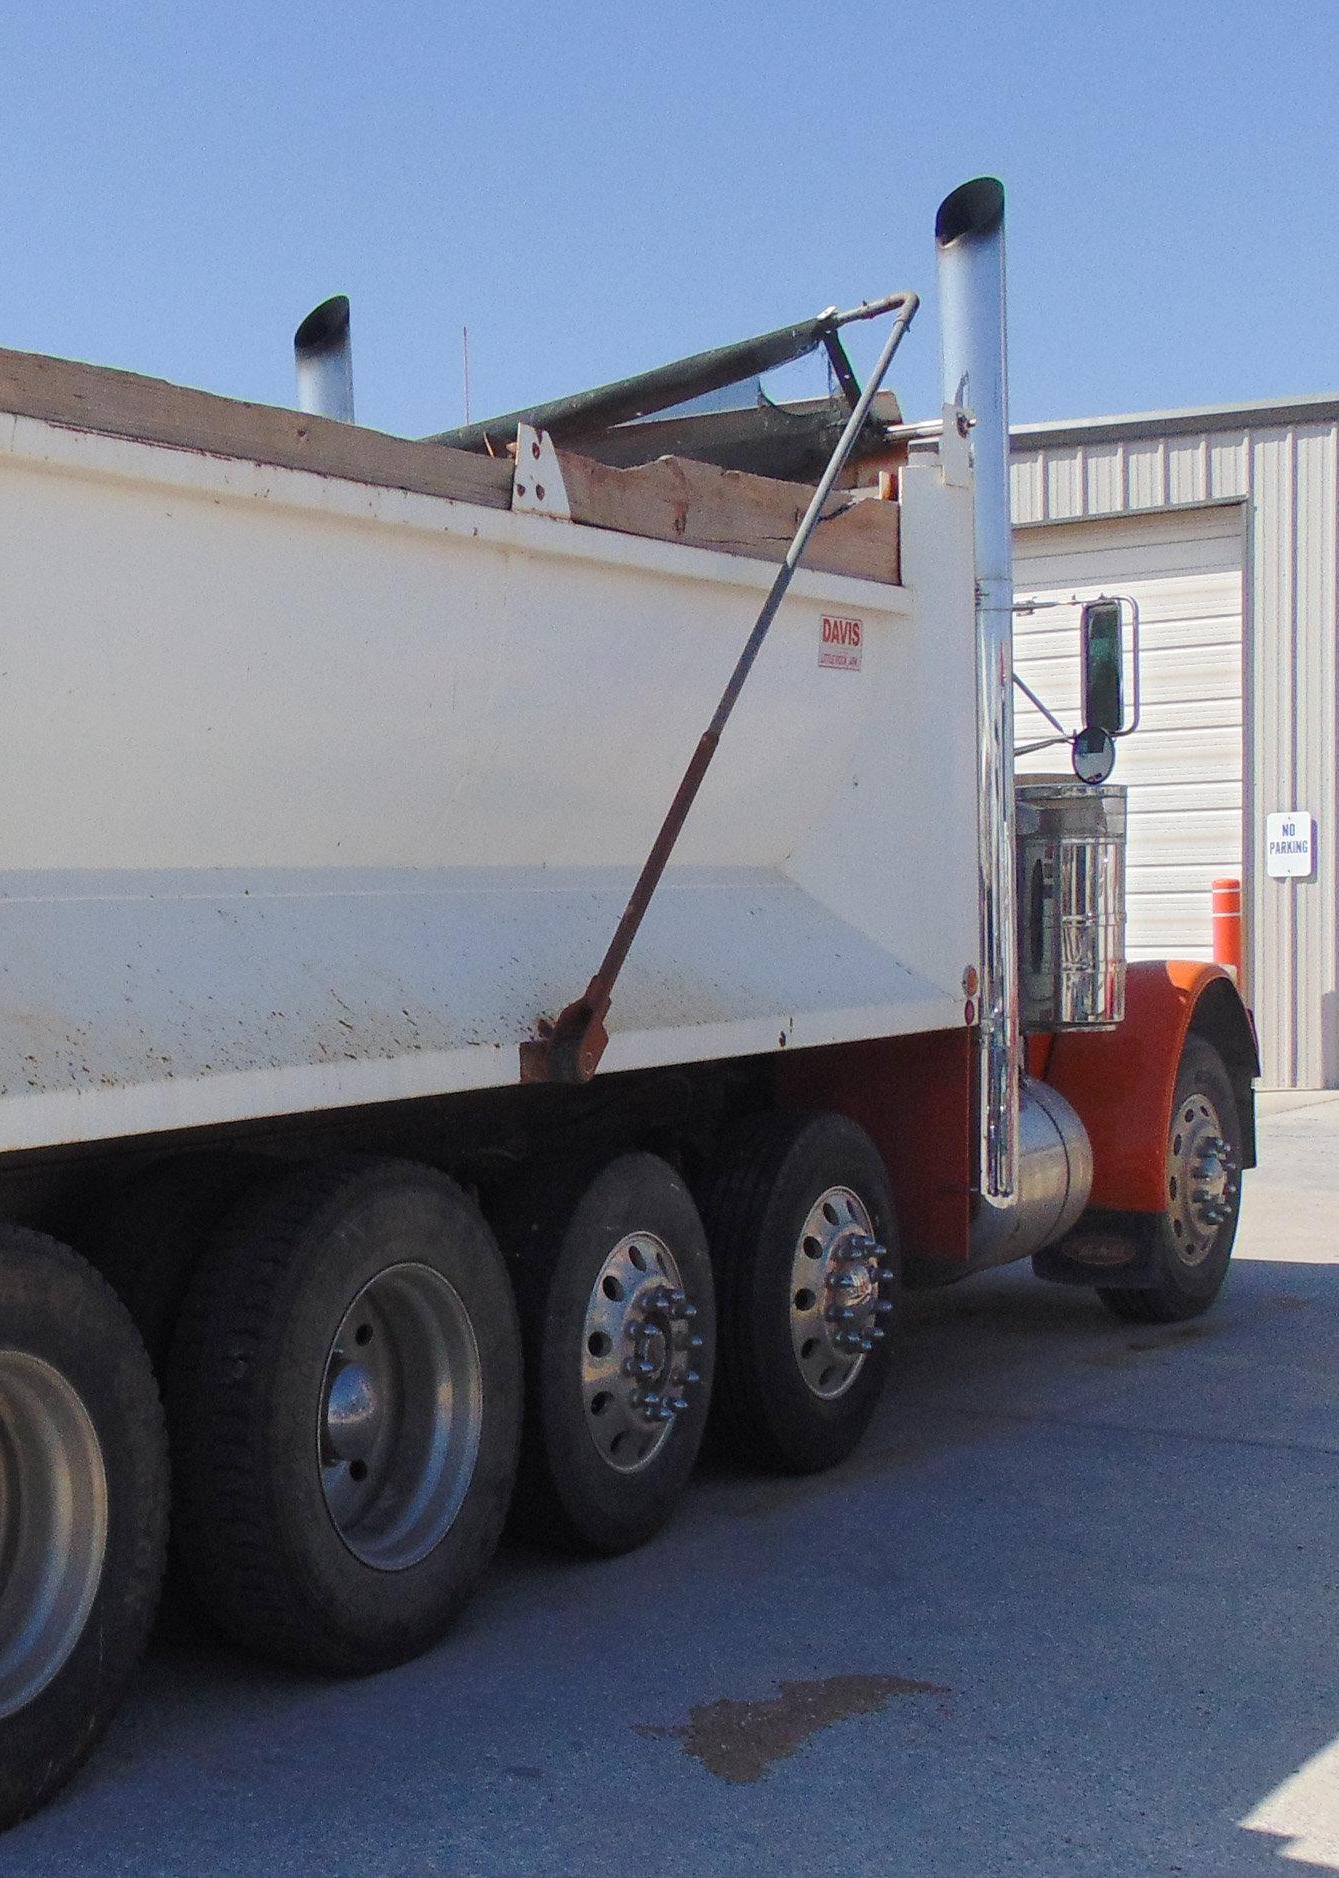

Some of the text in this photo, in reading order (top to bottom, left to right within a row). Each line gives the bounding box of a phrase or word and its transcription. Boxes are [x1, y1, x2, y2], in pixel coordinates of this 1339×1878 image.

[822, 618, 860, 646] DAVIS
[1282, 823, 1296, 837] NO
[1269, 840, 1308, 855] PARKING
